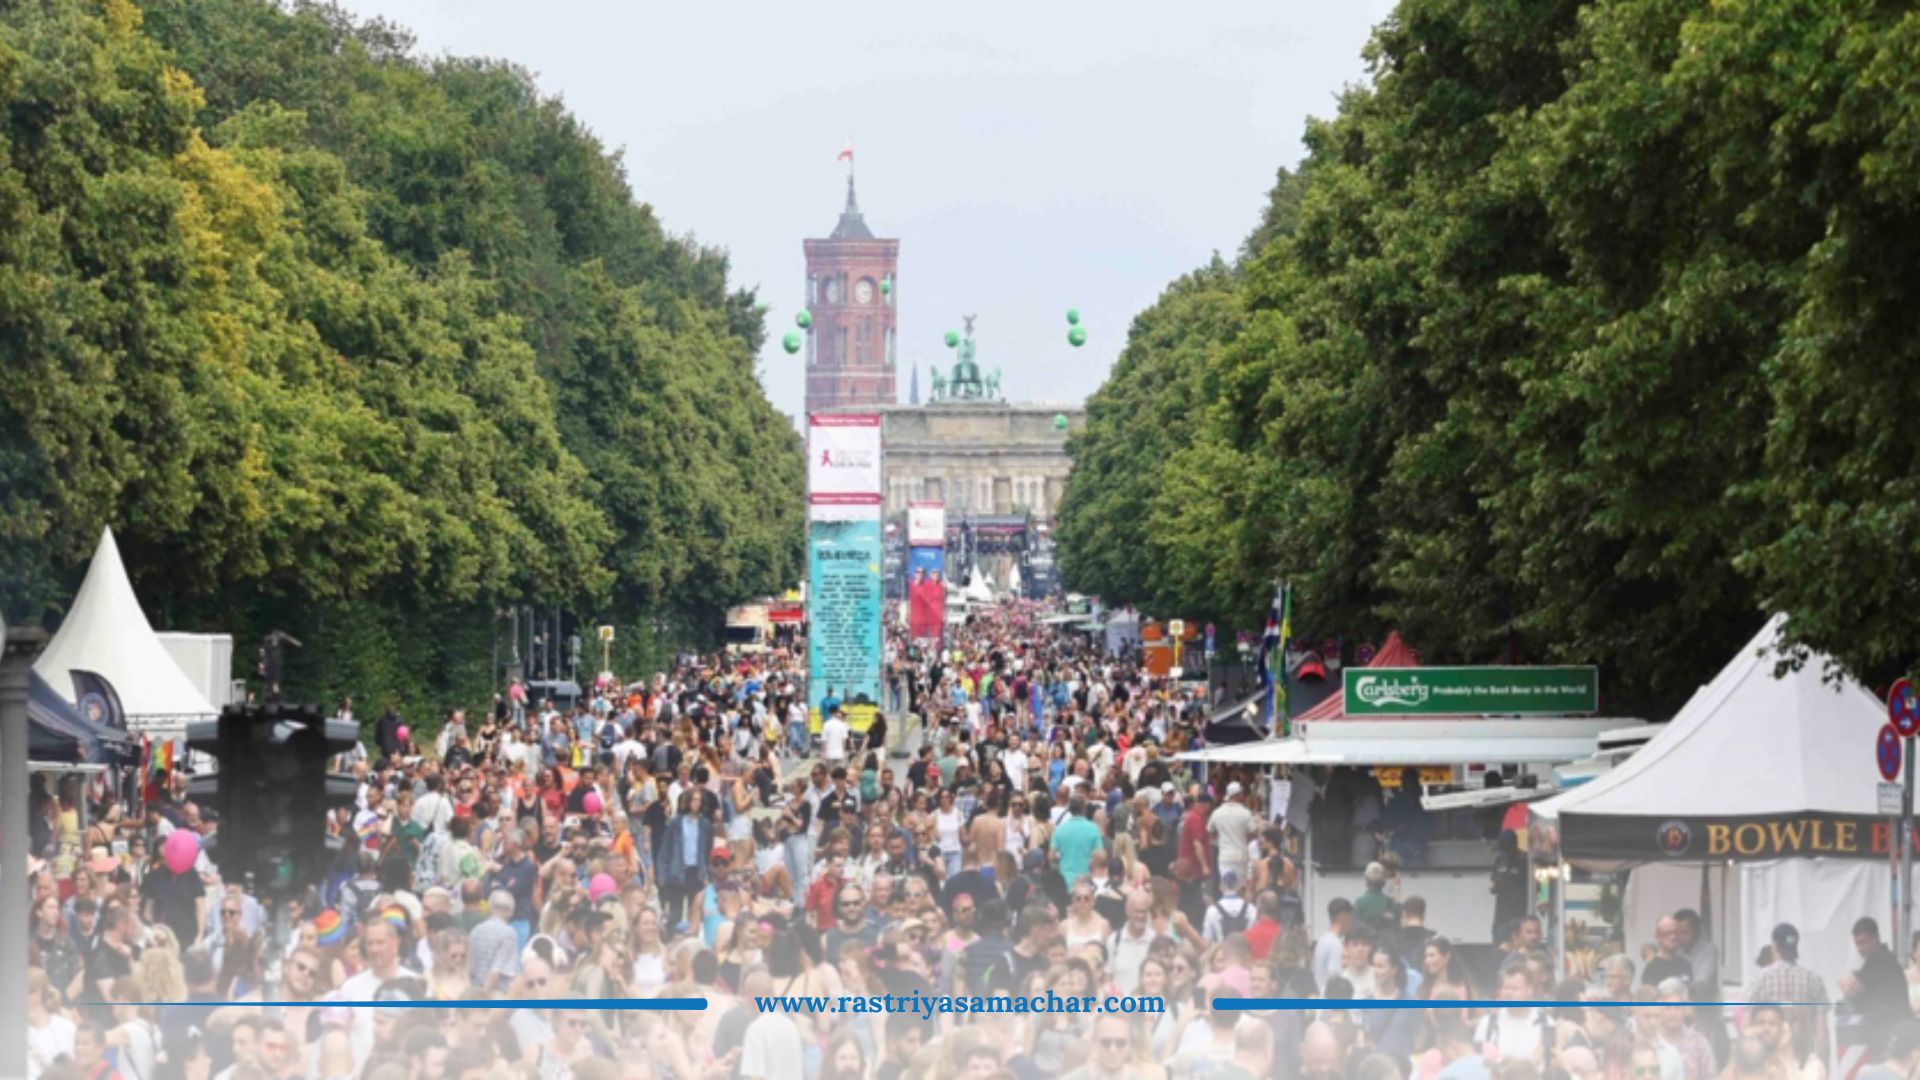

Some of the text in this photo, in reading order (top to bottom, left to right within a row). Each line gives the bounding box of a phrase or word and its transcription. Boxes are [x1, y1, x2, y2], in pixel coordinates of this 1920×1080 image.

[1355, 675, 1429, 707] Carlsberg
[1432, 685, 1473, 697] Probably
[1473, 685, 1489, 695] the
[1489, 685, 1510, 695] Best
[1511, 685, 1532, 695] Beer
[1544, 684, 1559, 694] the
[1560, 683, 1588, 694] World
[1706, 819, 1857, 855] BOWLE
